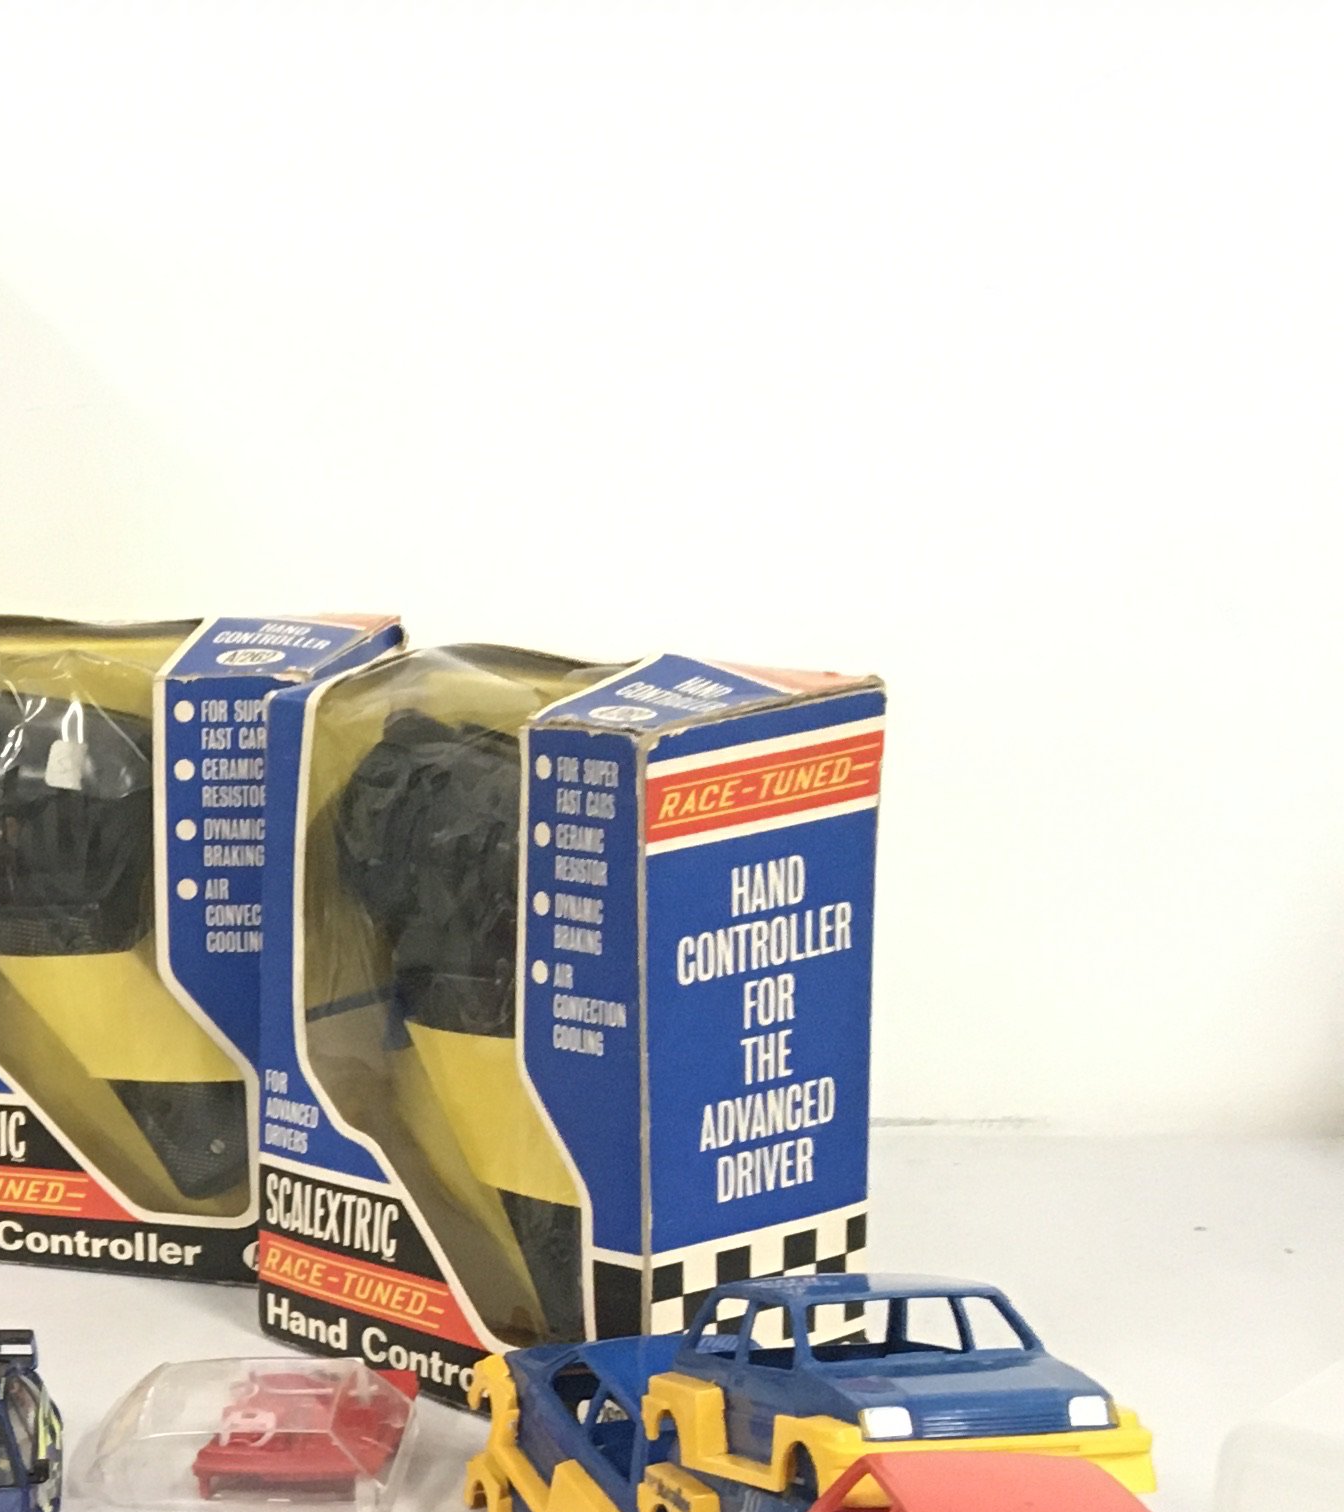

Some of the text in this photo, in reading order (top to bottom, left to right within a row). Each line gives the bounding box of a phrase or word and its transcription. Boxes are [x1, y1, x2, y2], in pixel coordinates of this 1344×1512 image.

[213, 630, 332, 650] CONTROLLER
[260, 622, 312, 636] HAND
[200, 700, 228, 723] FOR
[201, 727, 267, 750] FAST CAR
[201, 758, 264, 780] CERAMIC
[203, 819, 265, 841] DYNAMIC
[203, 845, 265, 867] BRAKING
[204, 878, 229, 900] AIR
[731, 855, 806, 916] HAND
[205, 905, 262, 927] CONVEC
[206, 931, 263, 953] COOLIN
[676, 902, 852, 986] CONTROLLER
[743, 973, 795, 1030] FOR
[740, 1029, 793, 1085] THE
[265, 1069, 288, 1095] FOR
[265, 1098, 319, 1129] ADVANCED
[700, 1076, 836, 1152] ADVANCED
[264, 1124, 308, 1154] DRIVERS
[717, 1137, 814, 1204] DRIVER
[266, 1173, 400, 1258] SCALEXTRIC
[266, 1294, 476, 1393] Hand Contro
